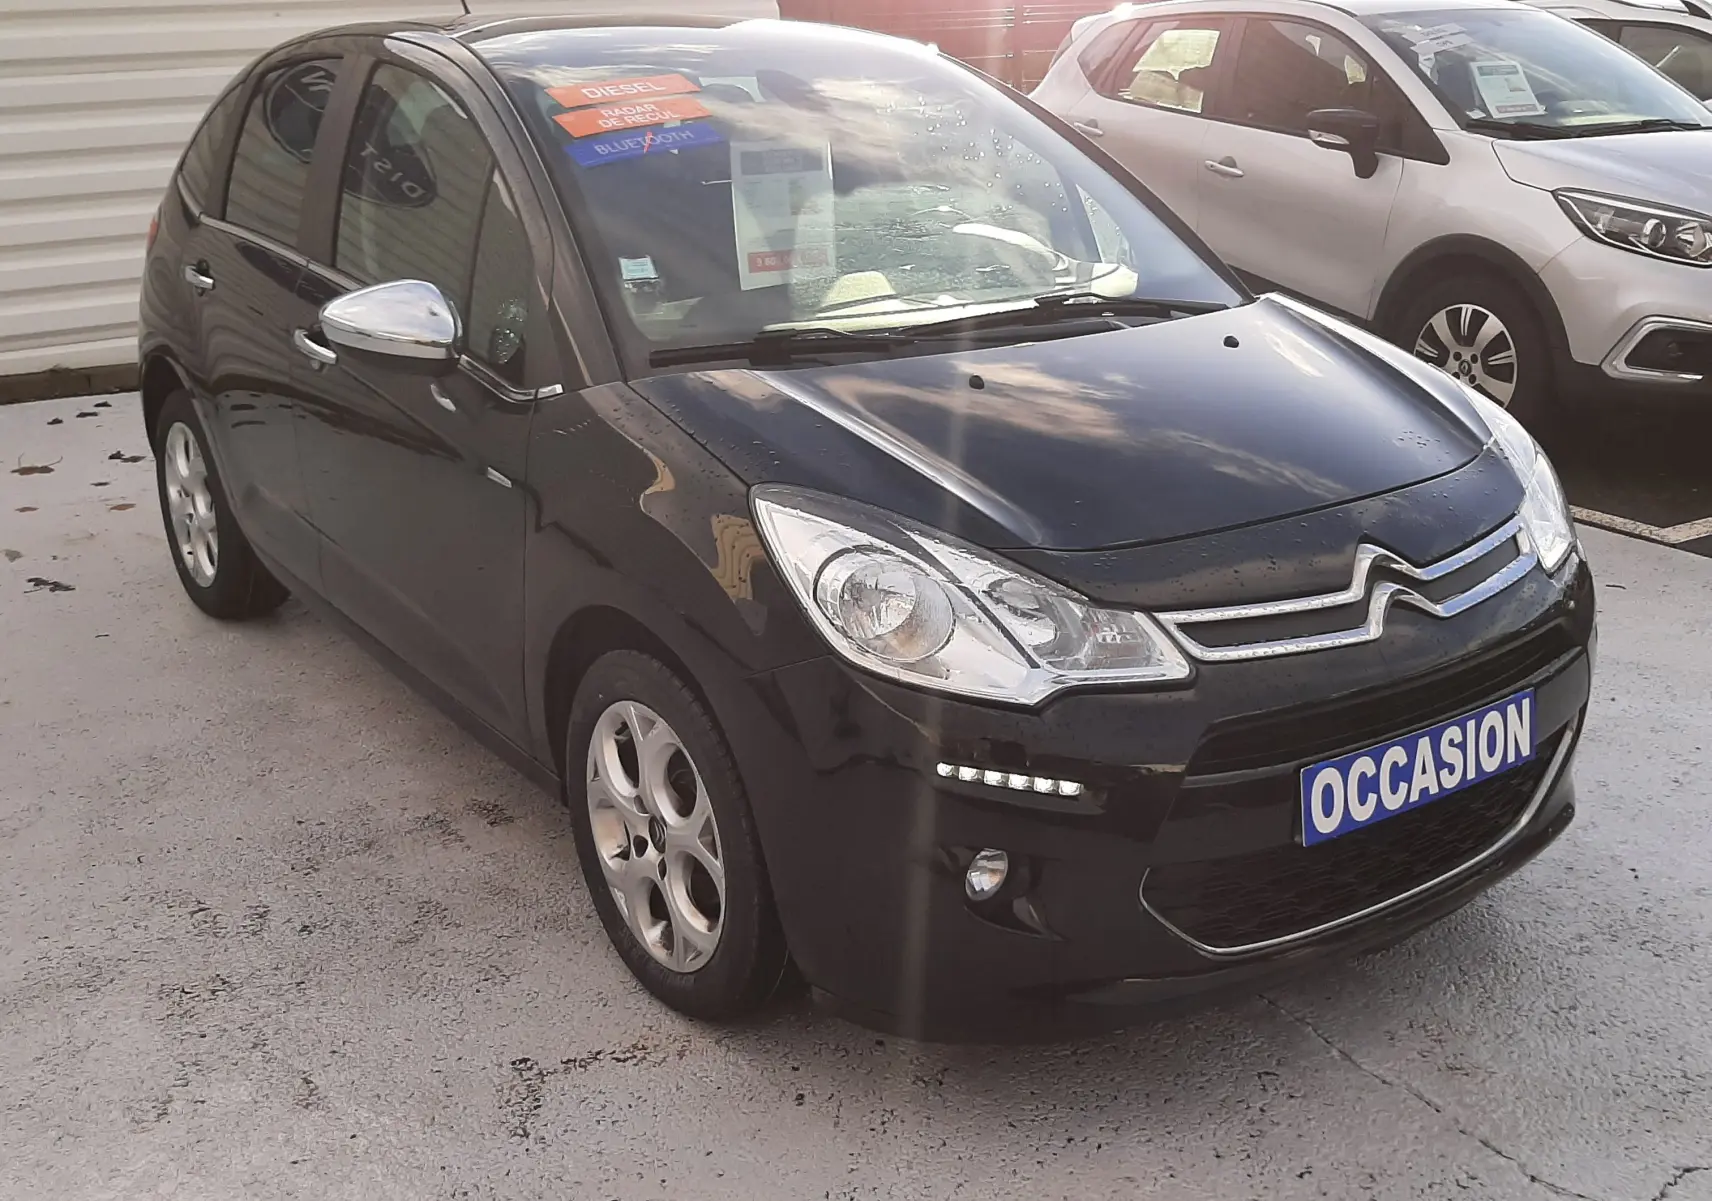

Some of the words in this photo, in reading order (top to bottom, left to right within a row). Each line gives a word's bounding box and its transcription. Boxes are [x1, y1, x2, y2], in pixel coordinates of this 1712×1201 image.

[581, 82, 667, 99] DIESEL
[601, 103, 660, 118] RADAR
[598, 117, 625, 129] DE
[627, 111, 680, 125] RECUL
[594, 130, 694, 155] BLUETOOTH
[1311, 698, 1531, 834] OCCASION
